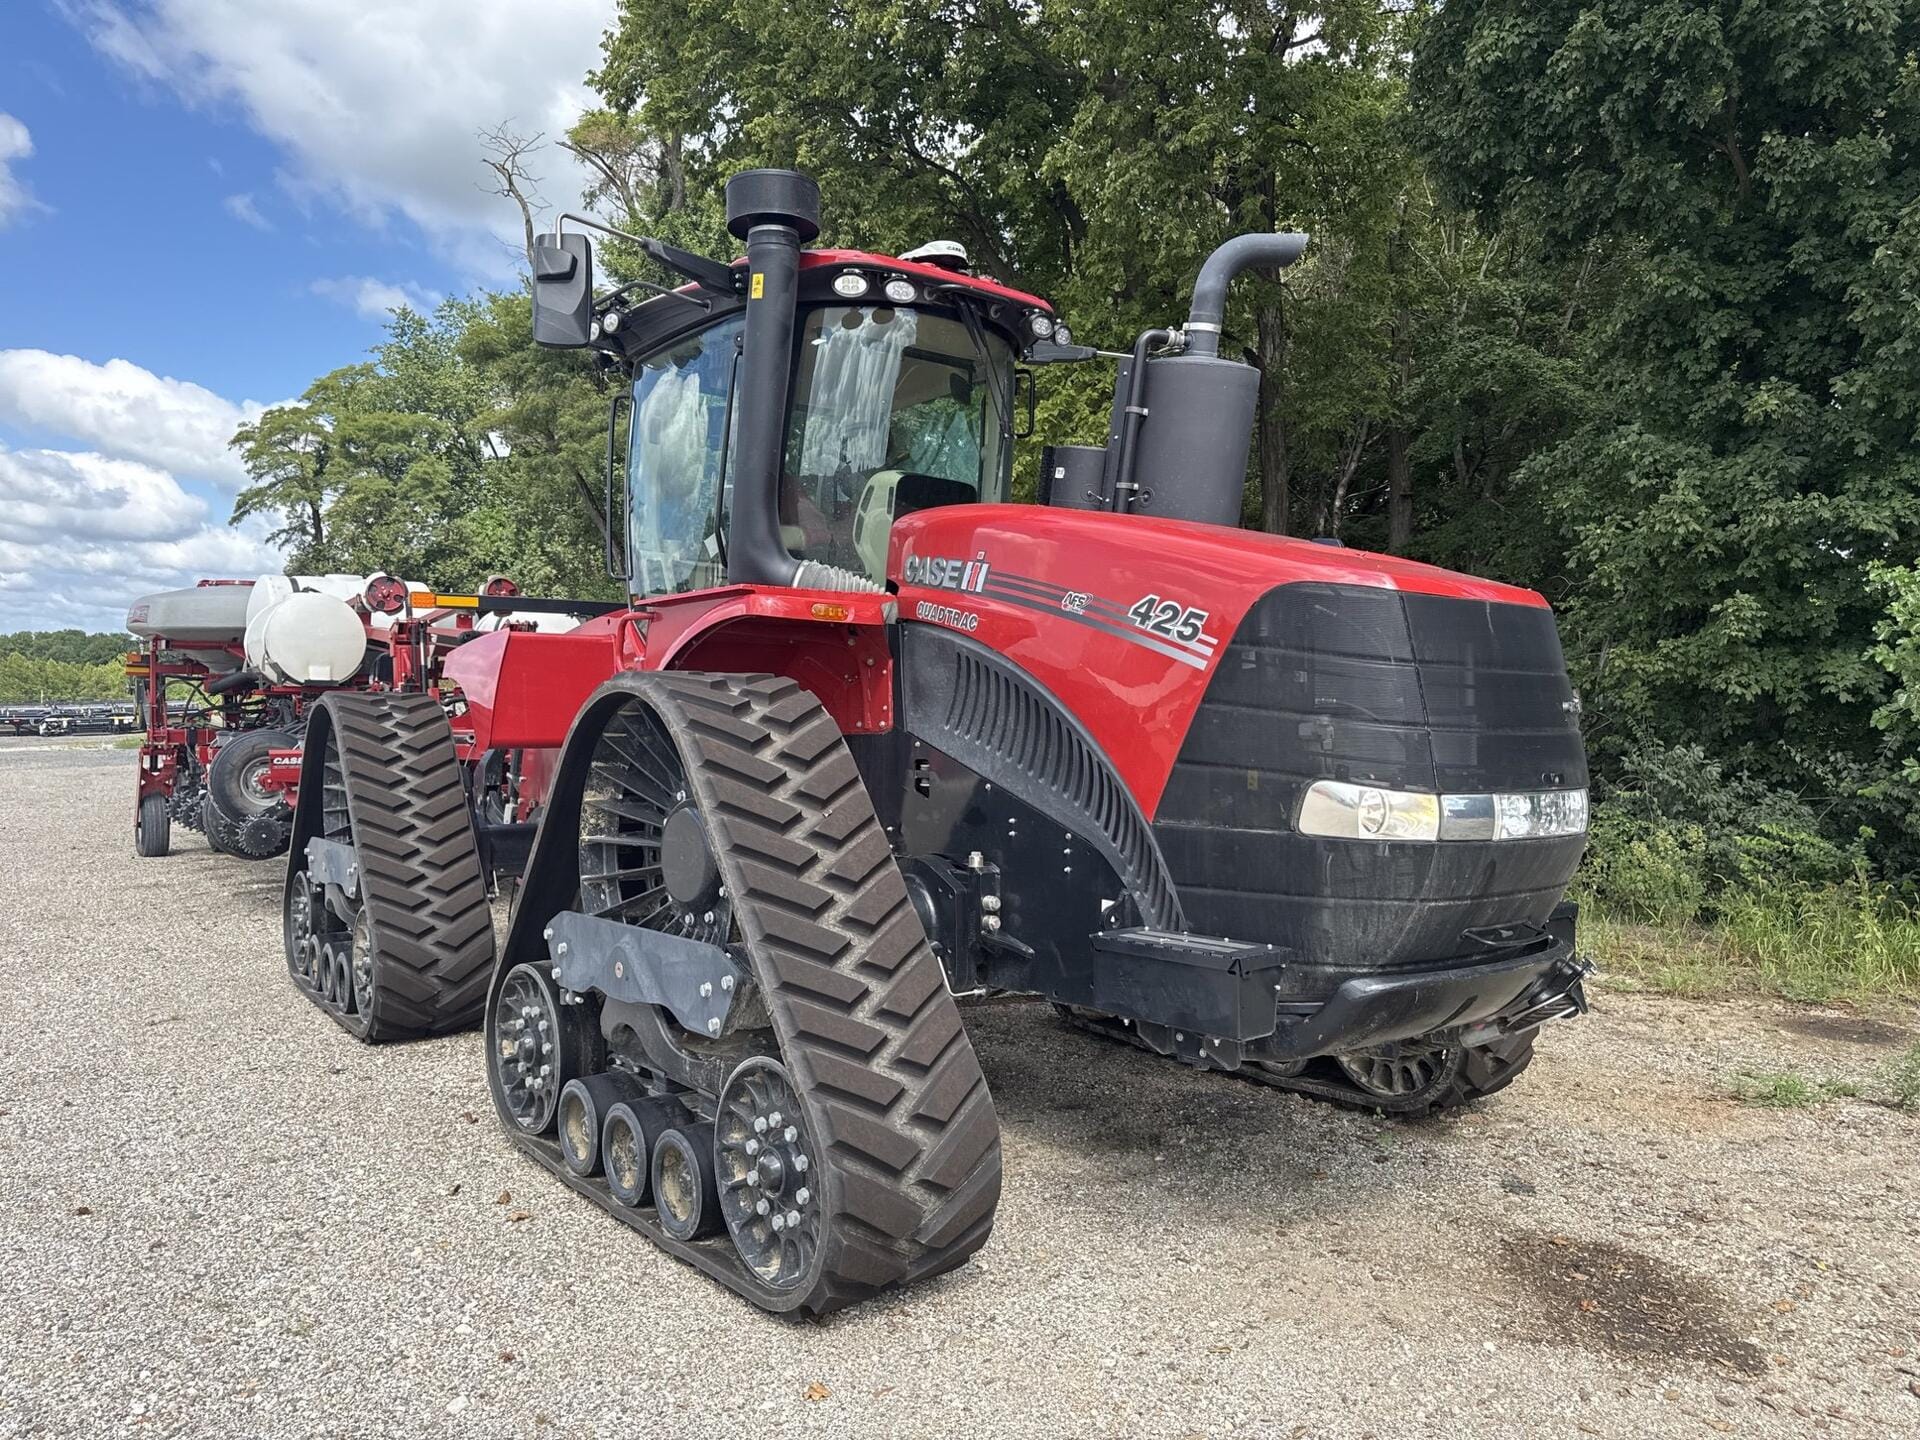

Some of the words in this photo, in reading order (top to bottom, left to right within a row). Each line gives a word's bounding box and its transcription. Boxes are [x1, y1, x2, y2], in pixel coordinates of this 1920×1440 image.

[904, 555, 962, 589] CASE
[1062, 592, 1087, 608] AFS
[916, 601, 978, 632] QUADTRAC
[1128, 594, 1209, 643] 425
